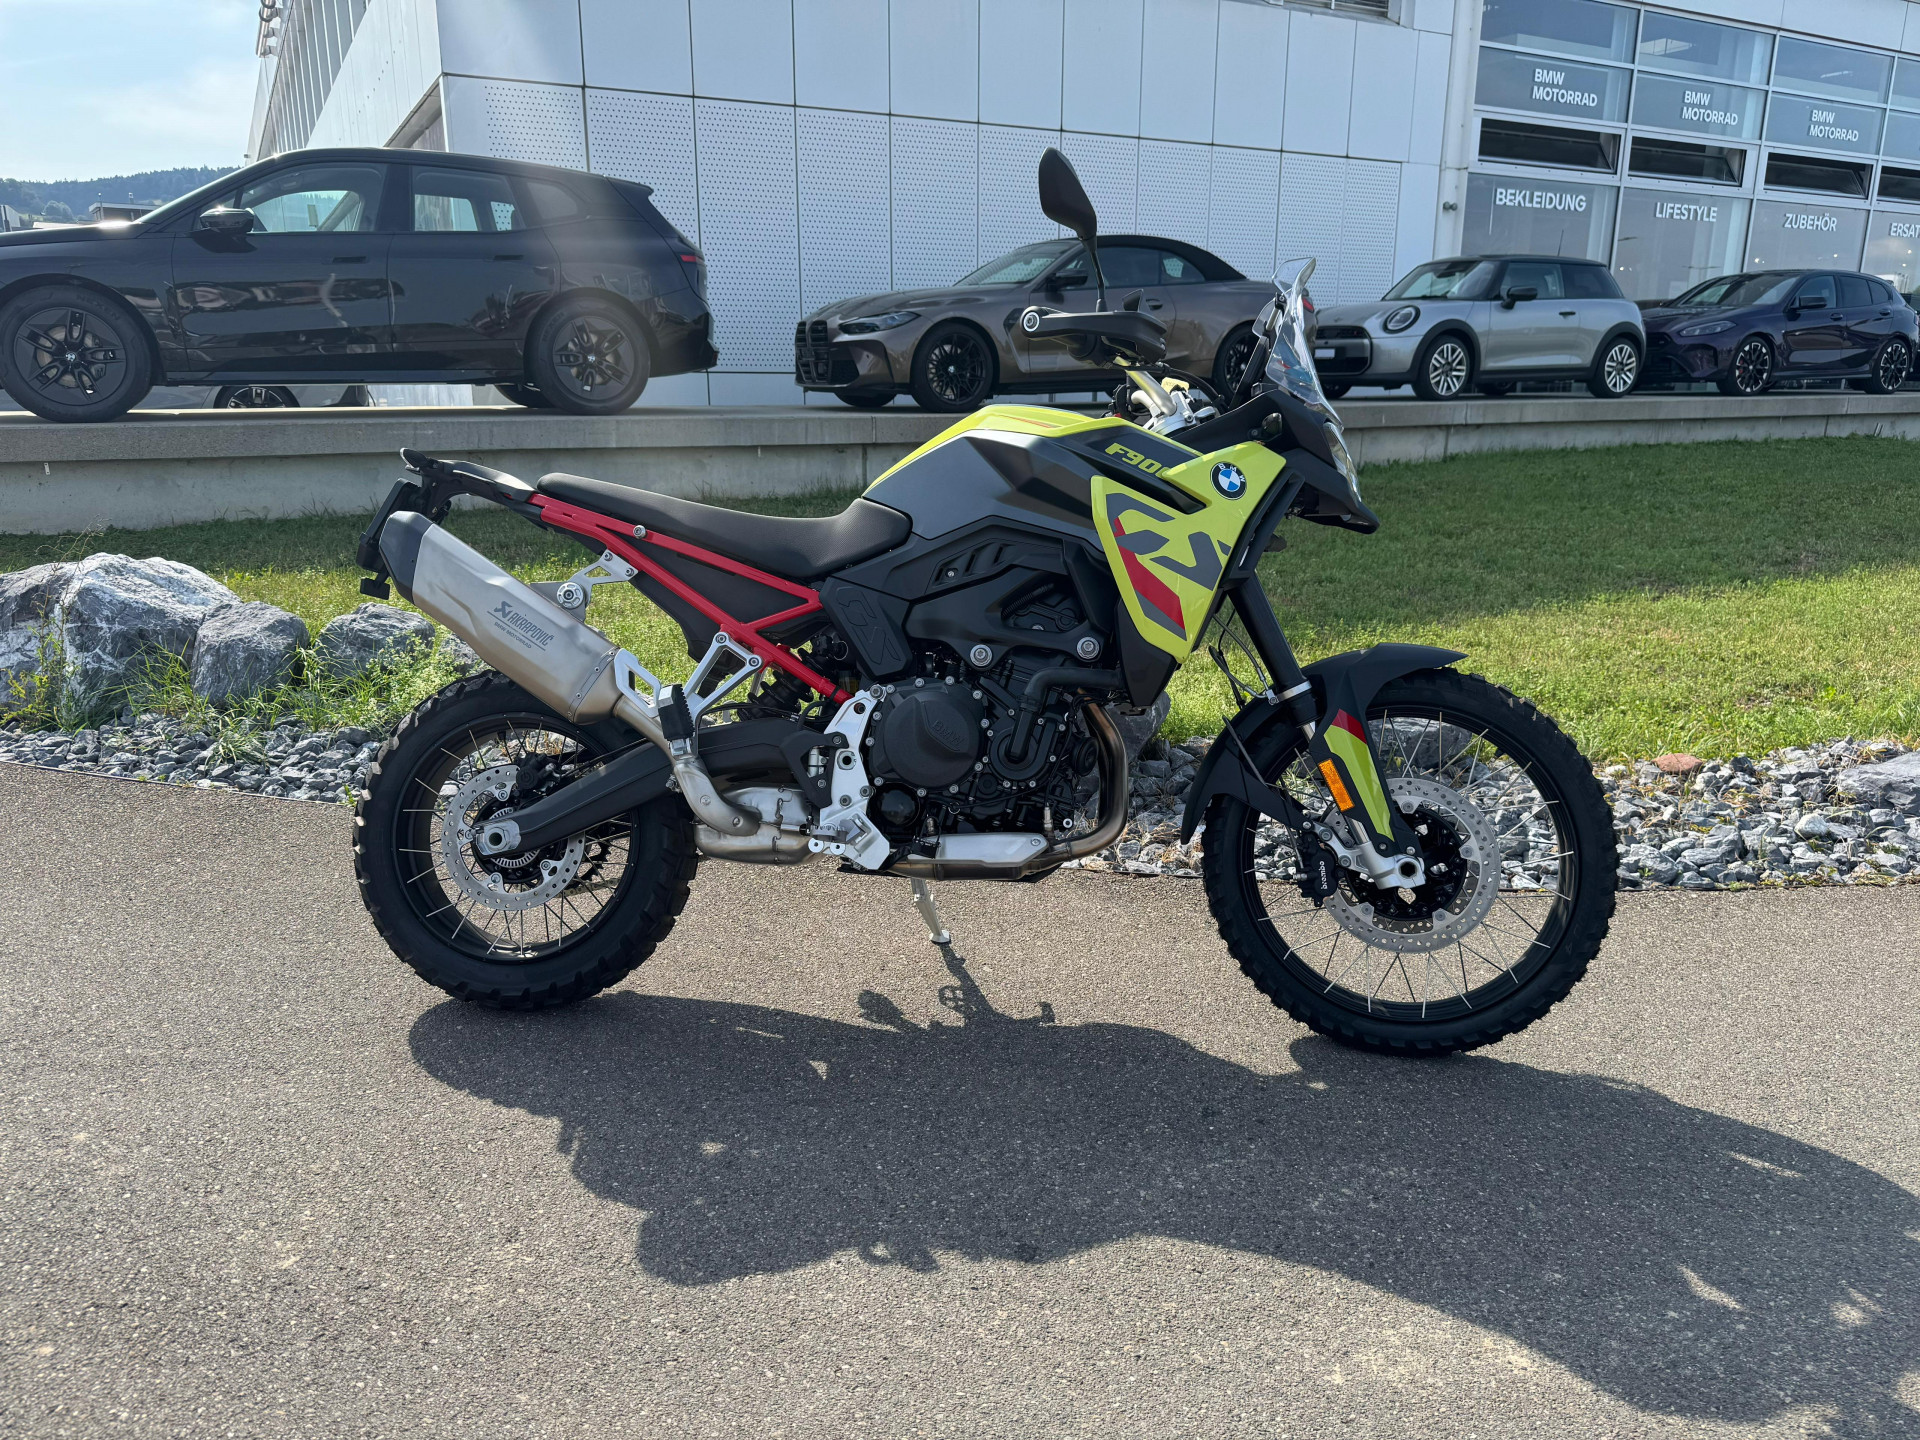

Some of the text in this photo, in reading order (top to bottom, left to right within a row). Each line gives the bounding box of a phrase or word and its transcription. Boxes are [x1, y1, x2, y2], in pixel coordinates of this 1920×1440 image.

[1534, 68, 1565, 85] BMW
[1532, 85, 1598, 107] MOTORRAD
[1684, 90, 1711, 106] BMW
[1682, 106, 1738, 126] MOTORRAD
[1811, 109, 1835, 124] BMW
[1809, 124, 1859, 142] MOTORRAD
[1495, 187, 1587, 212] BEKLEIDUNG
[1655, 201, 1718, 222] LIFESTYLE
[1784, 212, 1837, 232] ZUBEHÖR
[1890, 222, 1920, 238] ERSAT
[1217, 462, 1246, 483] BMW
[1318, 860, 1328, 890] brembo
